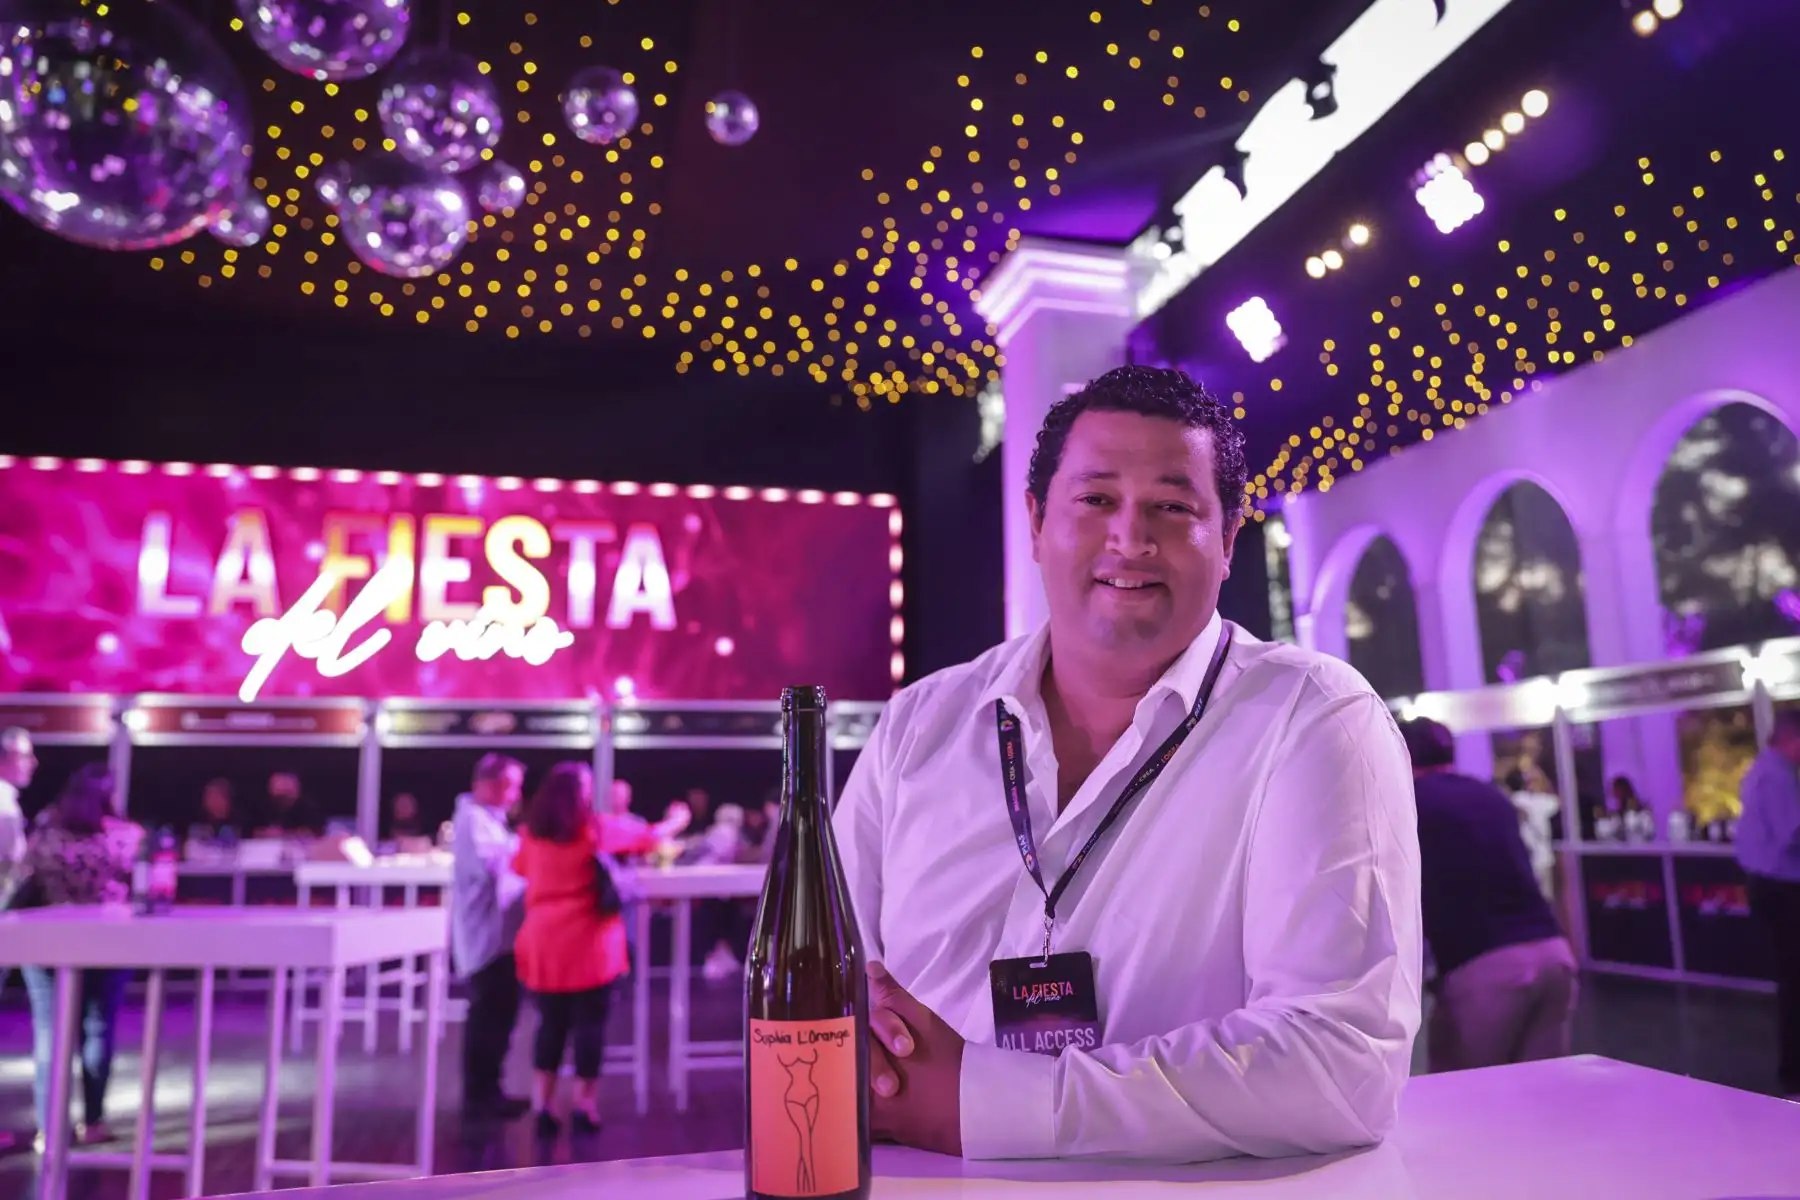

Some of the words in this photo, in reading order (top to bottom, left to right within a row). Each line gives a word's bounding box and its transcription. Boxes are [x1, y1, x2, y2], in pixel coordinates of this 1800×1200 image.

[137, 510, 282, 618] LA
[321, 509, 677, 631] FIESTA
[1013, 985, 1029, 1000] LA
[1032, 981, 1074, 998] FIESTA
[1002, 1032, 1031, 1051] ALL
[1034, 1027, 1096, 1051] ACCESS
